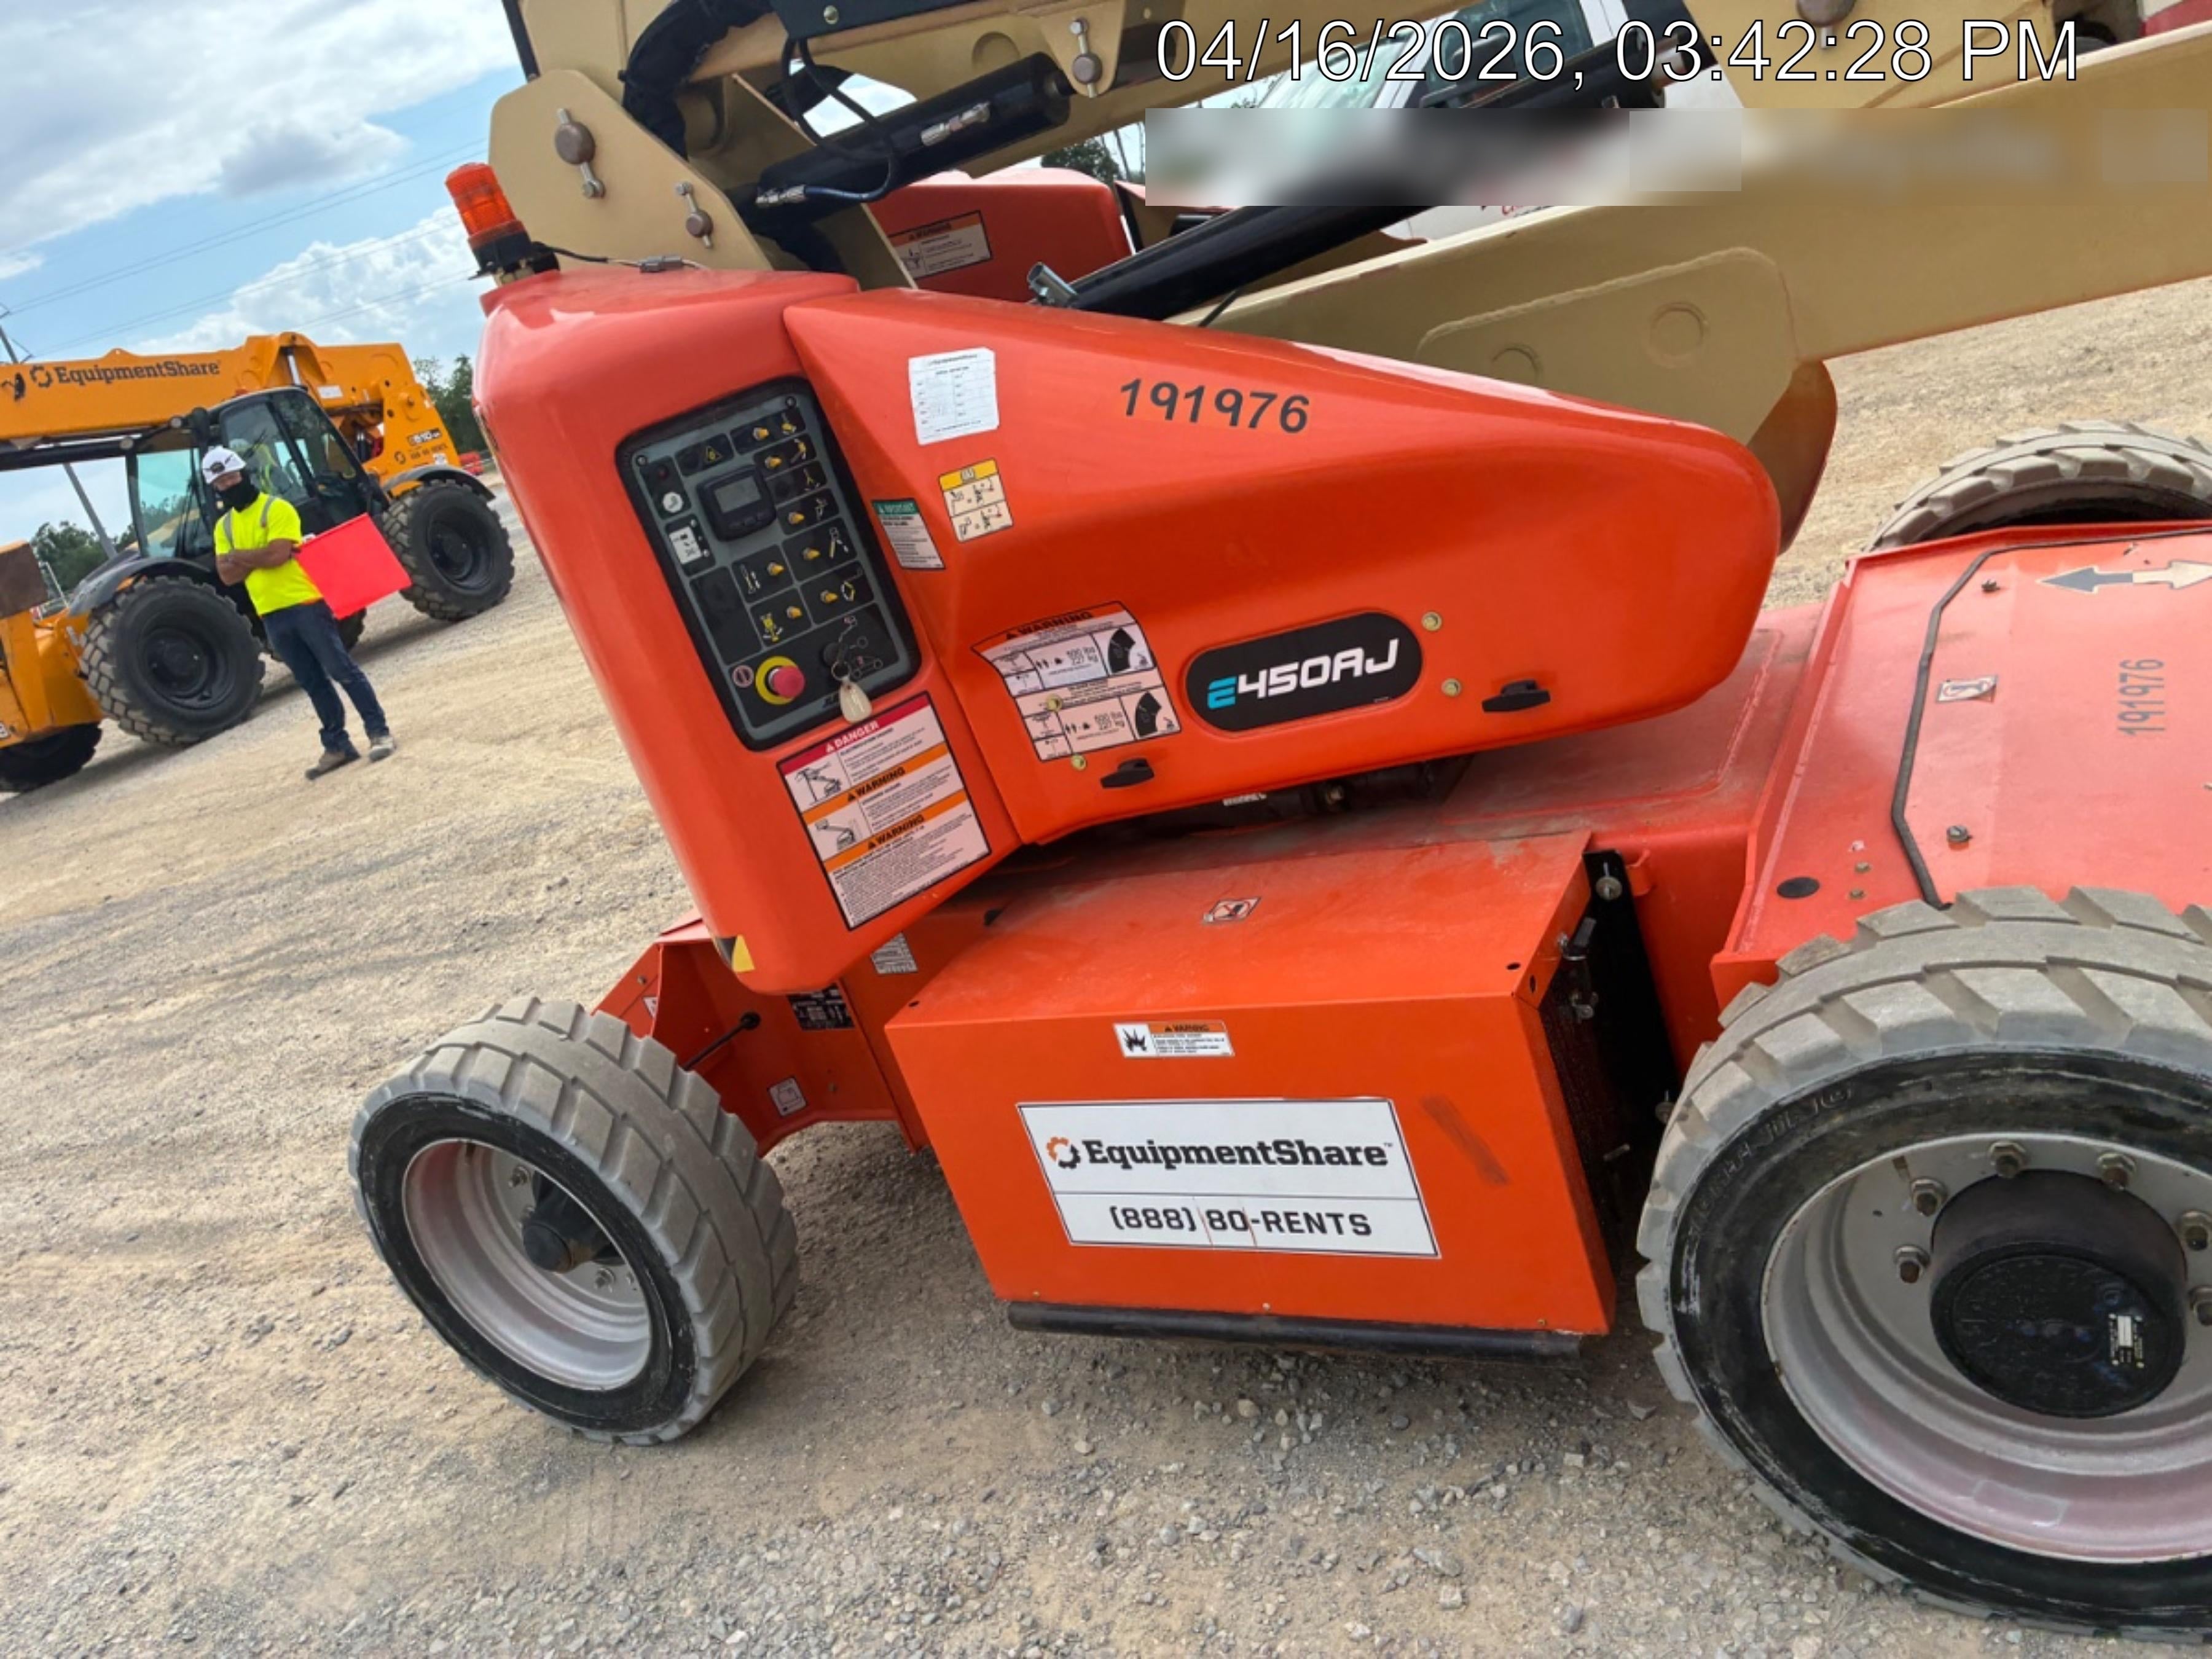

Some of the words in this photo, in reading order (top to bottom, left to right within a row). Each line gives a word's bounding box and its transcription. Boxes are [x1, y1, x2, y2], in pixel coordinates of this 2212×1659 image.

[1120, 377, 1310, 434] 191976
[1206, 637, 1400, 711] E450AJ
[2117, 659, 2166, 735] 191976
[834, 721, 880, 748] DANGER
[855, 767, 906, 797] WARNING
[877, 814, 925, 846] WARNING
[1109, 1206, 1196, 1232] (888)
[1205, 1209, 1372, 1236] 80-RENTS
